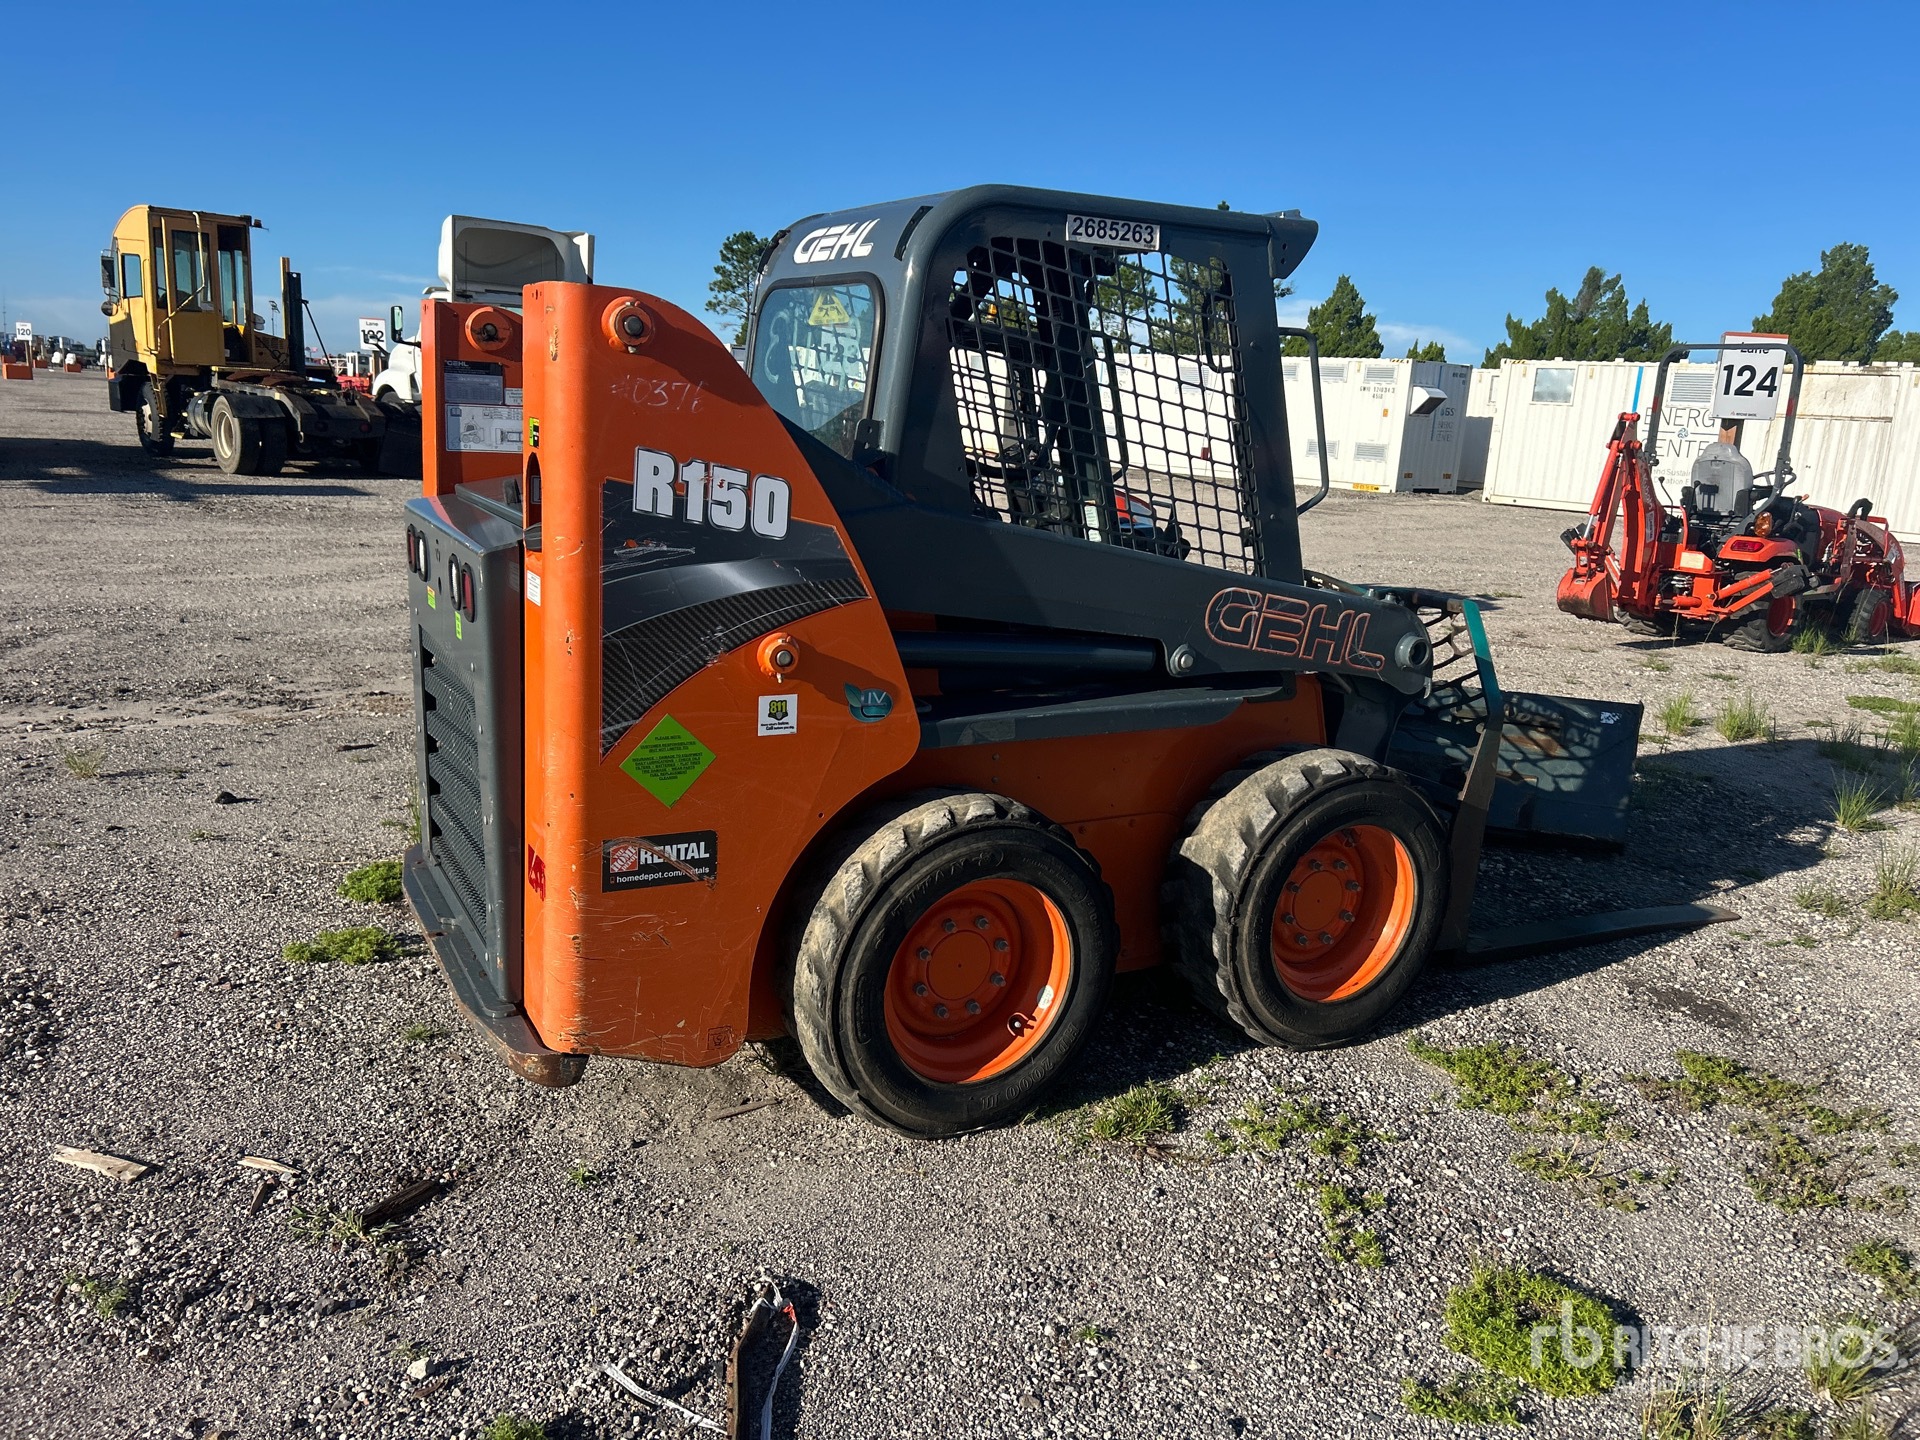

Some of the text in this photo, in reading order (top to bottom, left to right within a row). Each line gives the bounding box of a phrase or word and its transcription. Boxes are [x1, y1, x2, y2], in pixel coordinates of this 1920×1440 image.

[793, 217, 881, 265] GEHL
[1071, 216, 1155, 244] 2685263
[17, 327, 31, 336] 120
[1722, 364, 1779, 397] 124
[1643, 407, 1716, 428] ENERG
[1641, 438, 1710, 459] ENTE
[632, 444, 793, 541] R150
[1205, 586, 1387, 672] GEHL
[769, 700, 787, 713] 811
[610, 844, 638, 873] HOME
[621, 854, 639, 872] DEPOT
[640, 841, 710, 866] RENTAL
[616, 866, 710, 884] homedepot.com/rtals
